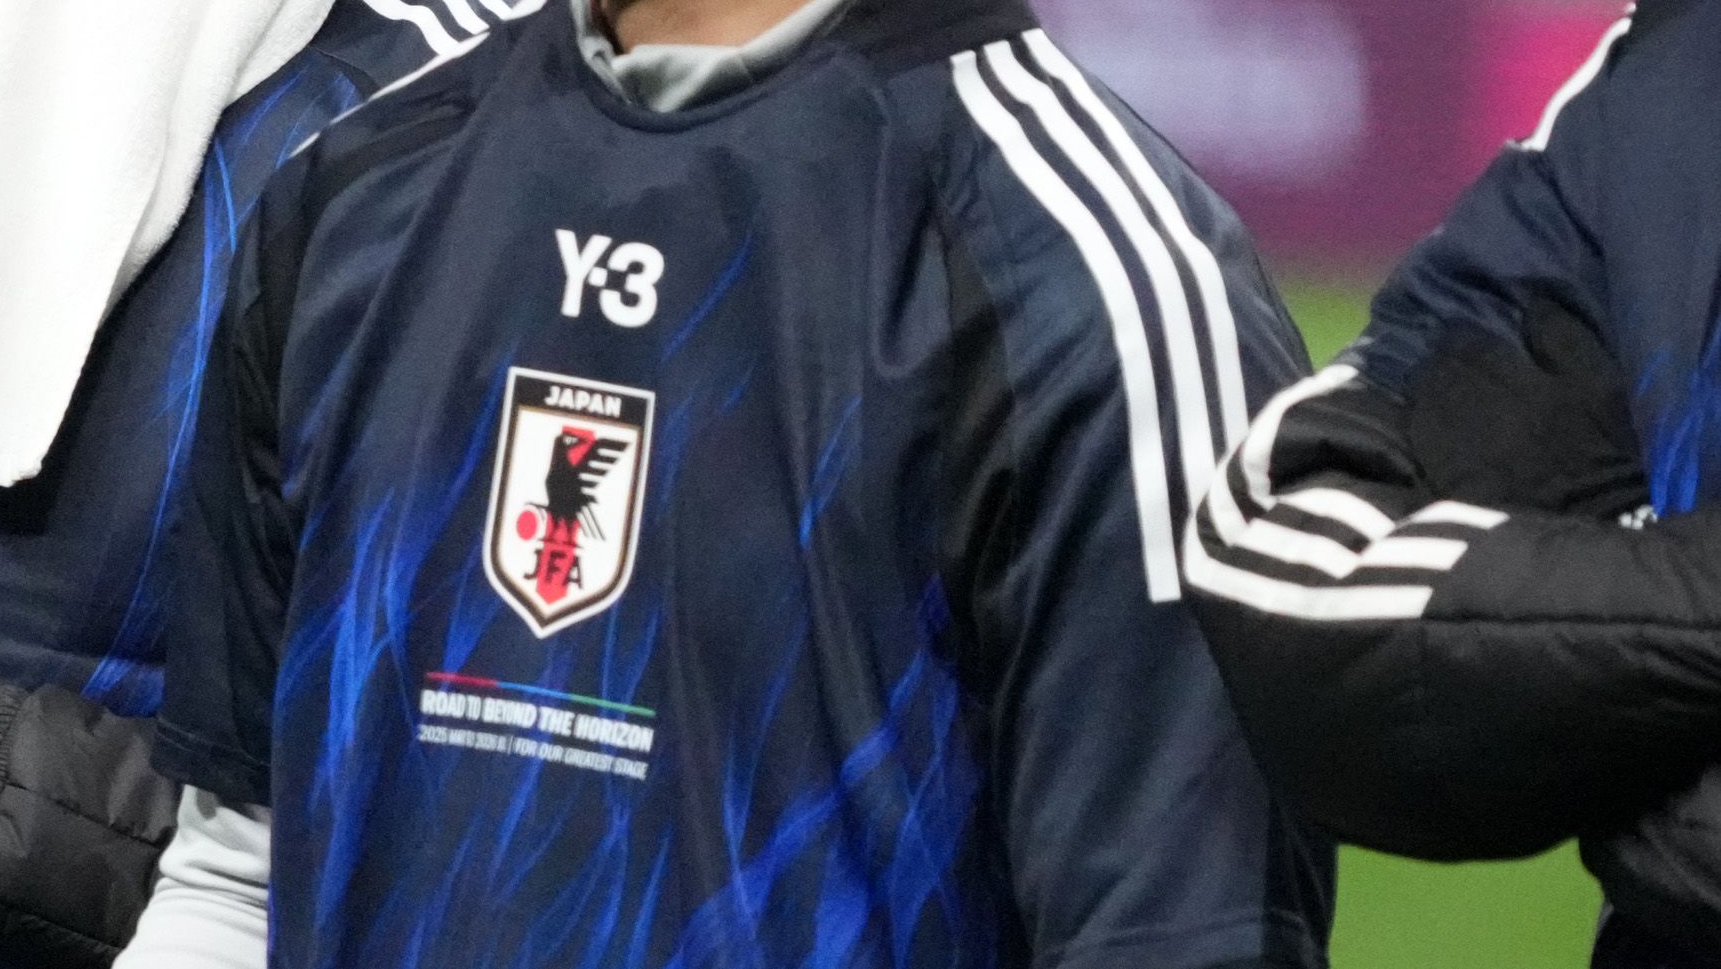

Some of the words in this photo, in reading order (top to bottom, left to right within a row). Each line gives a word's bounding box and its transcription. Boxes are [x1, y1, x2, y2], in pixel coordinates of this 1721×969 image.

[555, 228, 665, 328] Y-3
[544, 385, 623, 418] JAPAN
[523, 548, 583, 589] JFA
[420, 689, 465, 718] ROAD
[465, 695, 482, 720] TO
[482, 697, 538, 728] BEYOND
[538, 705, 576, 736] THE
[575, 714, 655, 752] HORIZON
[538, 742, 564, 762] OUR
[564, 747, 614, 772] GREATEST
[613, 756, 649, 781] STAGE
